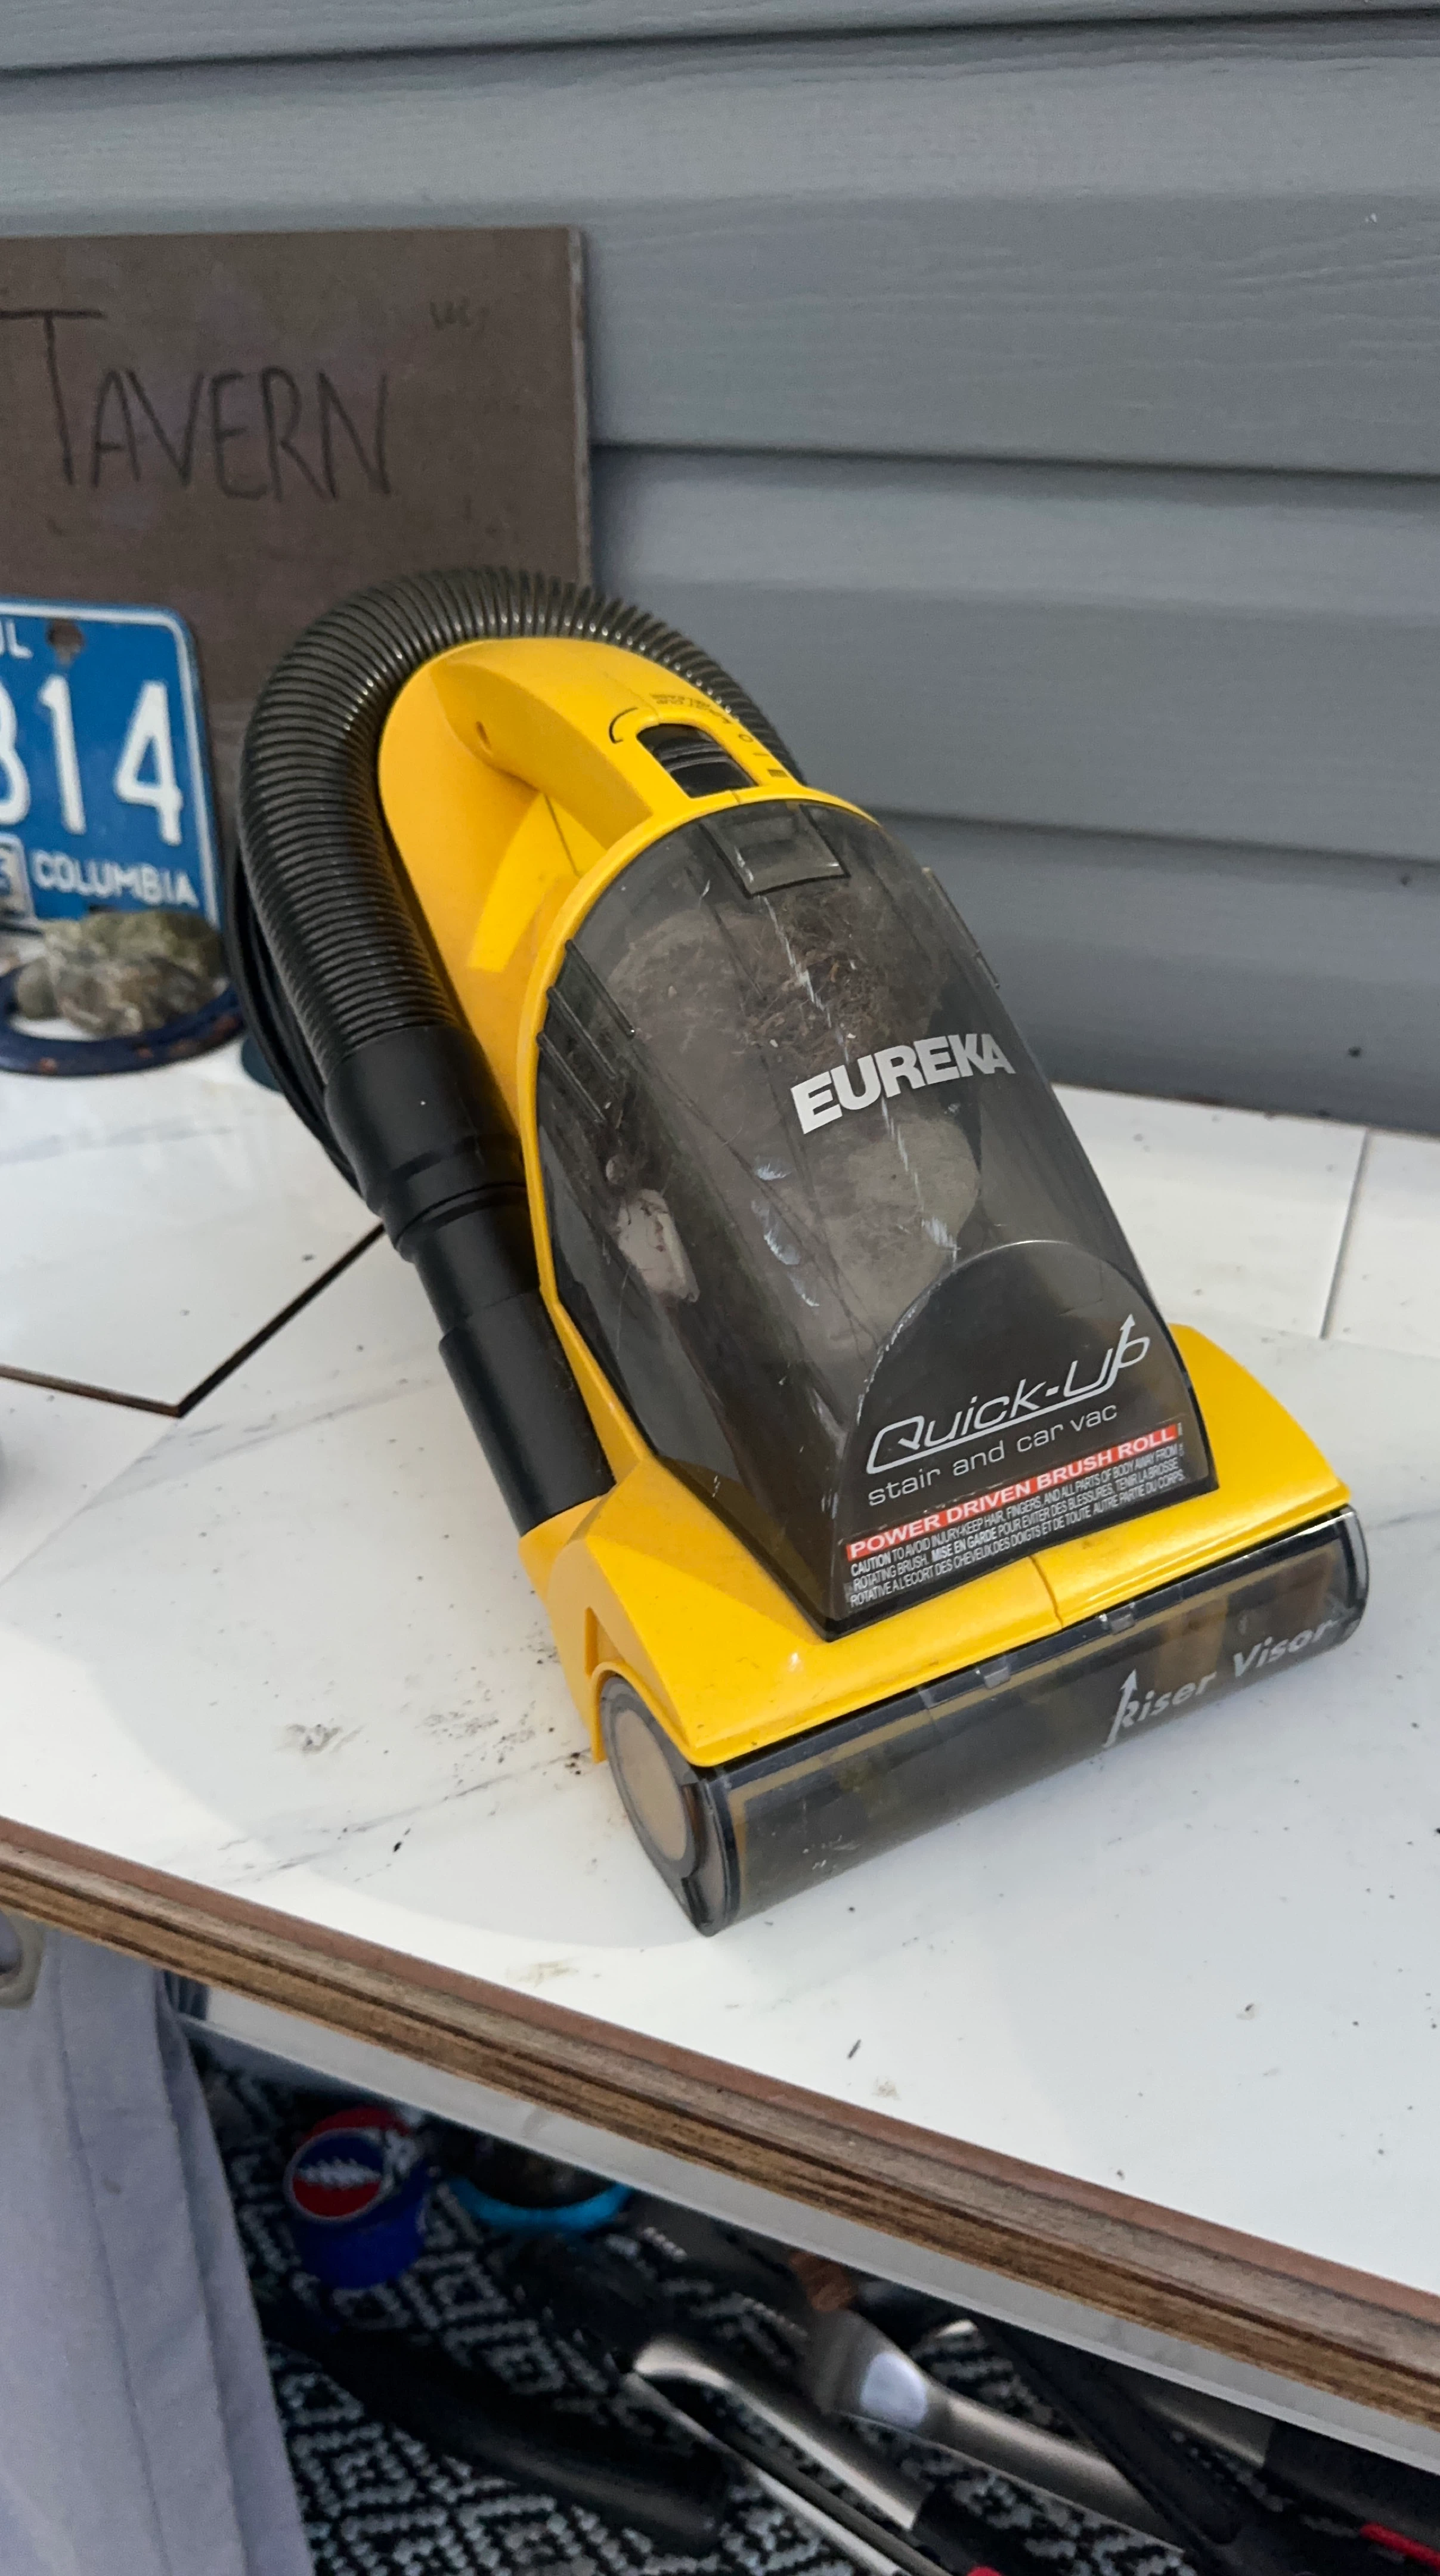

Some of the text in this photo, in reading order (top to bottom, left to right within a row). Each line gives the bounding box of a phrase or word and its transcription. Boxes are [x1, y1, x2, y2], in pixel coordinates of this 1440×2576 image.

[0, 308, 391, 502] TAVERN
[0, 621, 33, 659] L
[30, 849, 199, 908] COLUMBIA
[791, 1033, 1016, 1134] EUREKA
[850, 1429, 1177, 1558] POWER DRIVEN BRUSH ROLL
[868, 1404, 1117, 1506] stair and car vac
[850, 1581, 893, 1608] ROTATIVE
[934, 1558, 953, 1575] DES
[1010, 1525, 1041, 1547] DOIGTS
[1041, 1519, 1052, 1535] ET
[1052, 1515, 1065, 1531] DE
[1065, 1504, 1092, 1525] TOUTE
[1092, 1494, 1119, 1515] AUTRE
[1145, 1479, 1157, 1494] DU
[851, 1551, 891, 1577] CAUTION
[892, 1547, 905, 1561] TO
[905, 1538, 930, 1557] AVOID
[1044, 1488, 1061, 1504] AND
[1061, 1484, 1076, 1498] ALL
[1075, 1473, 1101, 1492] PARTS
[1101, 1468, 1111, 1483] OF
[1113, 1460, 1134, 1478] BODY
[853, 1565, 896, 1592] ROTATING
[931, 1543, 953, 1562] MISE
[953, 1538, 967, 1553] EN
[967, 1527, 998, 1549] GARDE
[998, 1518, 1021, 1537] POUR
[1051, 1500, 1067, 1516] DES
[1103, 1620, 1340, 1748] Riser Visor
